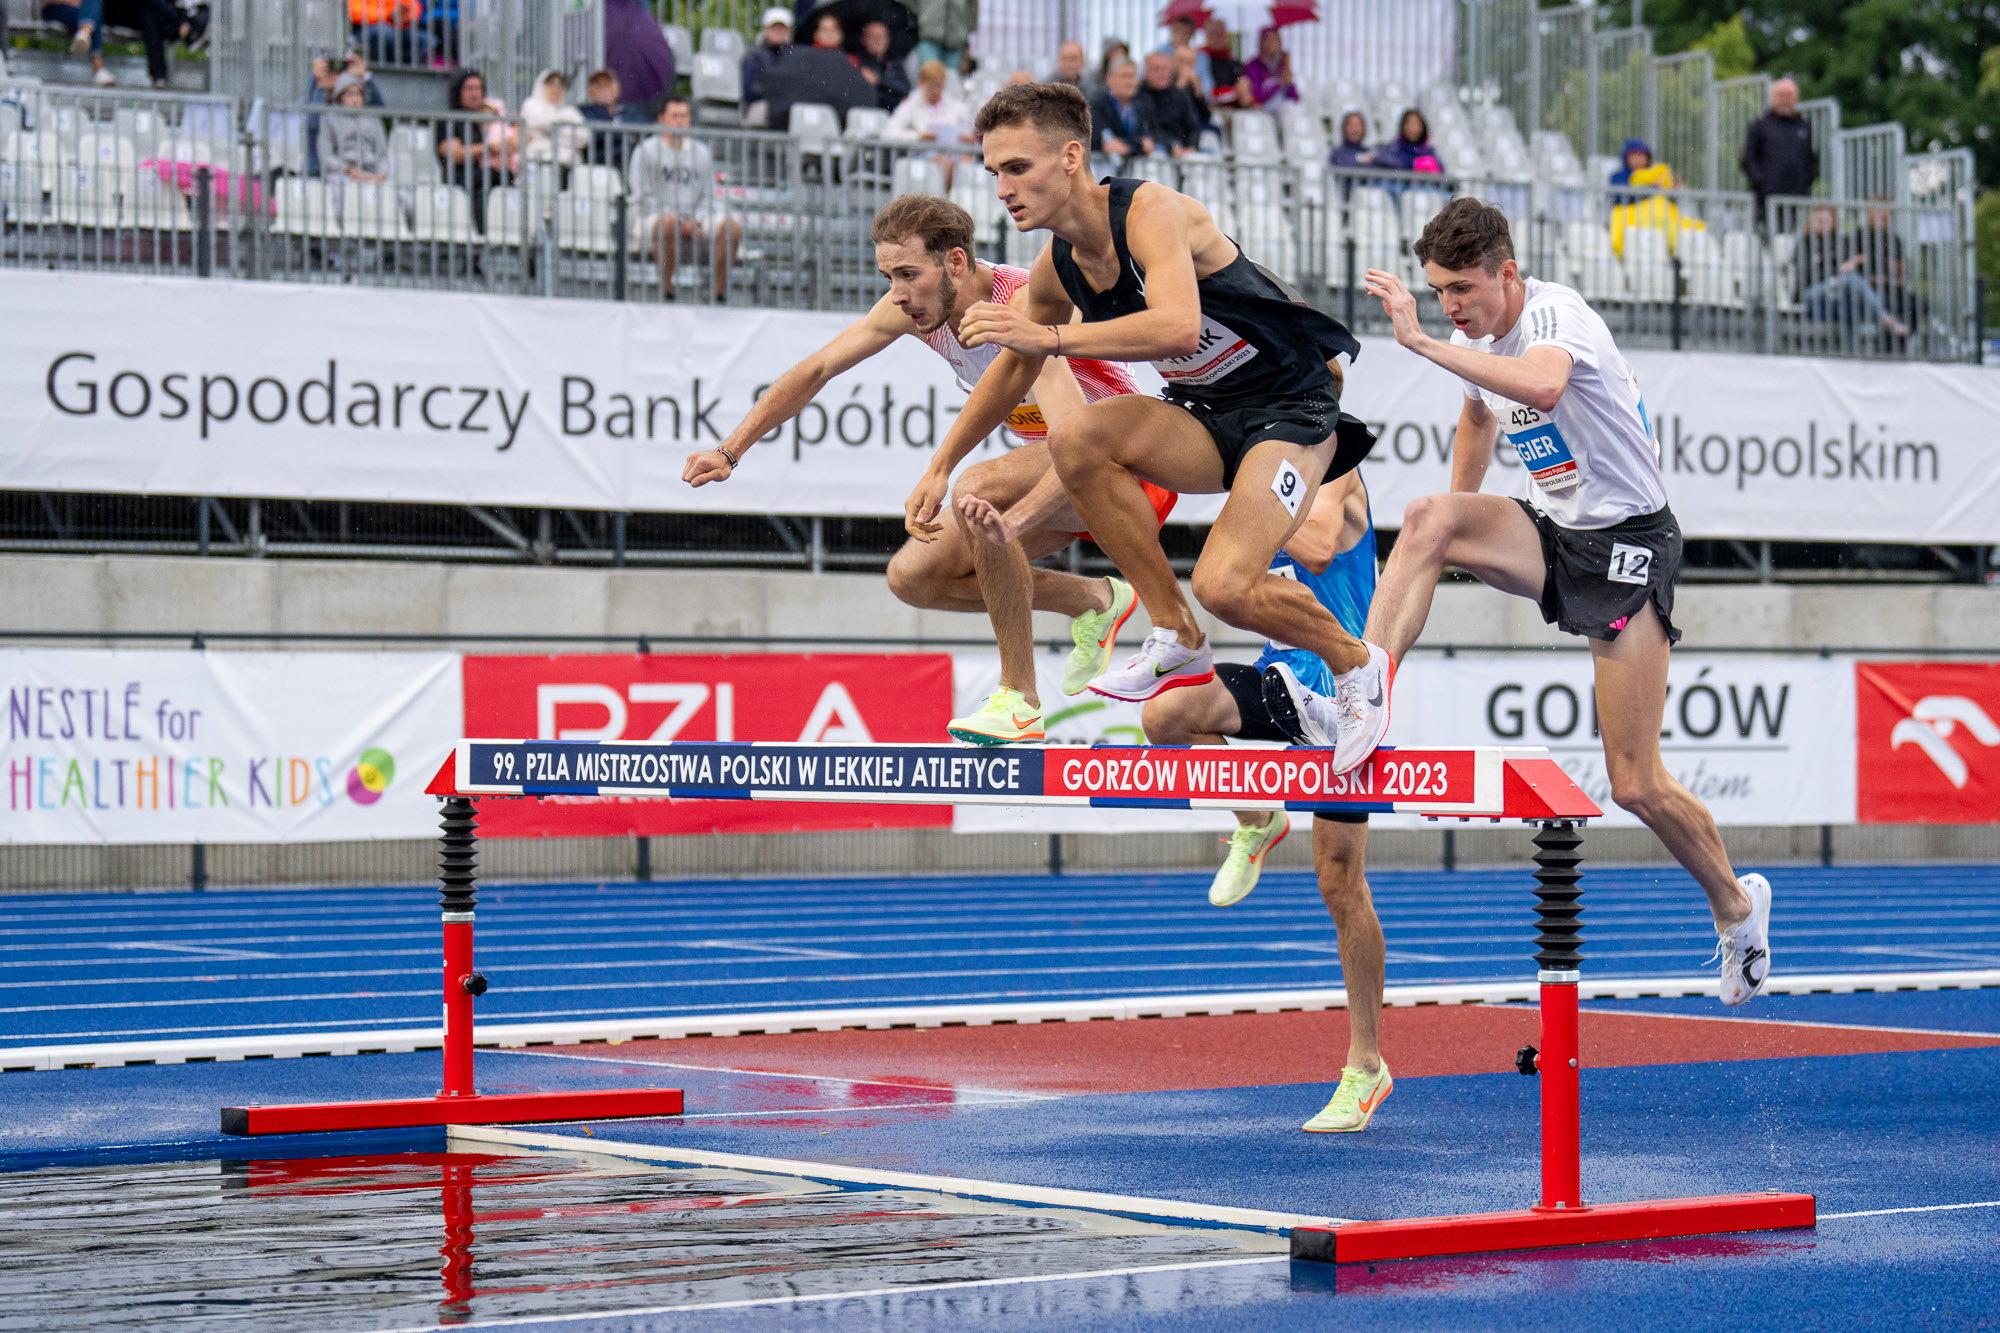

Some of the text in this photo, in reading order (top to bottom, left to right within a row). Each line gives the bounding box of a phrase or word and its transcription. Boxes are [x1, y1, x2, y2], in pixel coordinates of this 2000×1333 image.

[1218, 348, 1236, 362] Polski
[1233, 349, 1251, 362] 2023
[45, 351, 531, 452] Gospodarczy
[561, 375, 722, 441] Bank
[1511, 407, 1540, 427] 425
[1613, 551, 1649, 579] 12
[10, 682, 202, 741] NESTLÉ for
[1487, 667, 1790, 740] GOÓW
[9, 755, 334, 811] HEALTHIER KIDS
[493, 751, 1020, 789] 99. PZLA MISTRZOSTWA POLSKI W LEKKIEJ ATLETYCE
[1062, 750, 1178, 792] GORZÓW
[1382, 762, 1448, 796] 2023
